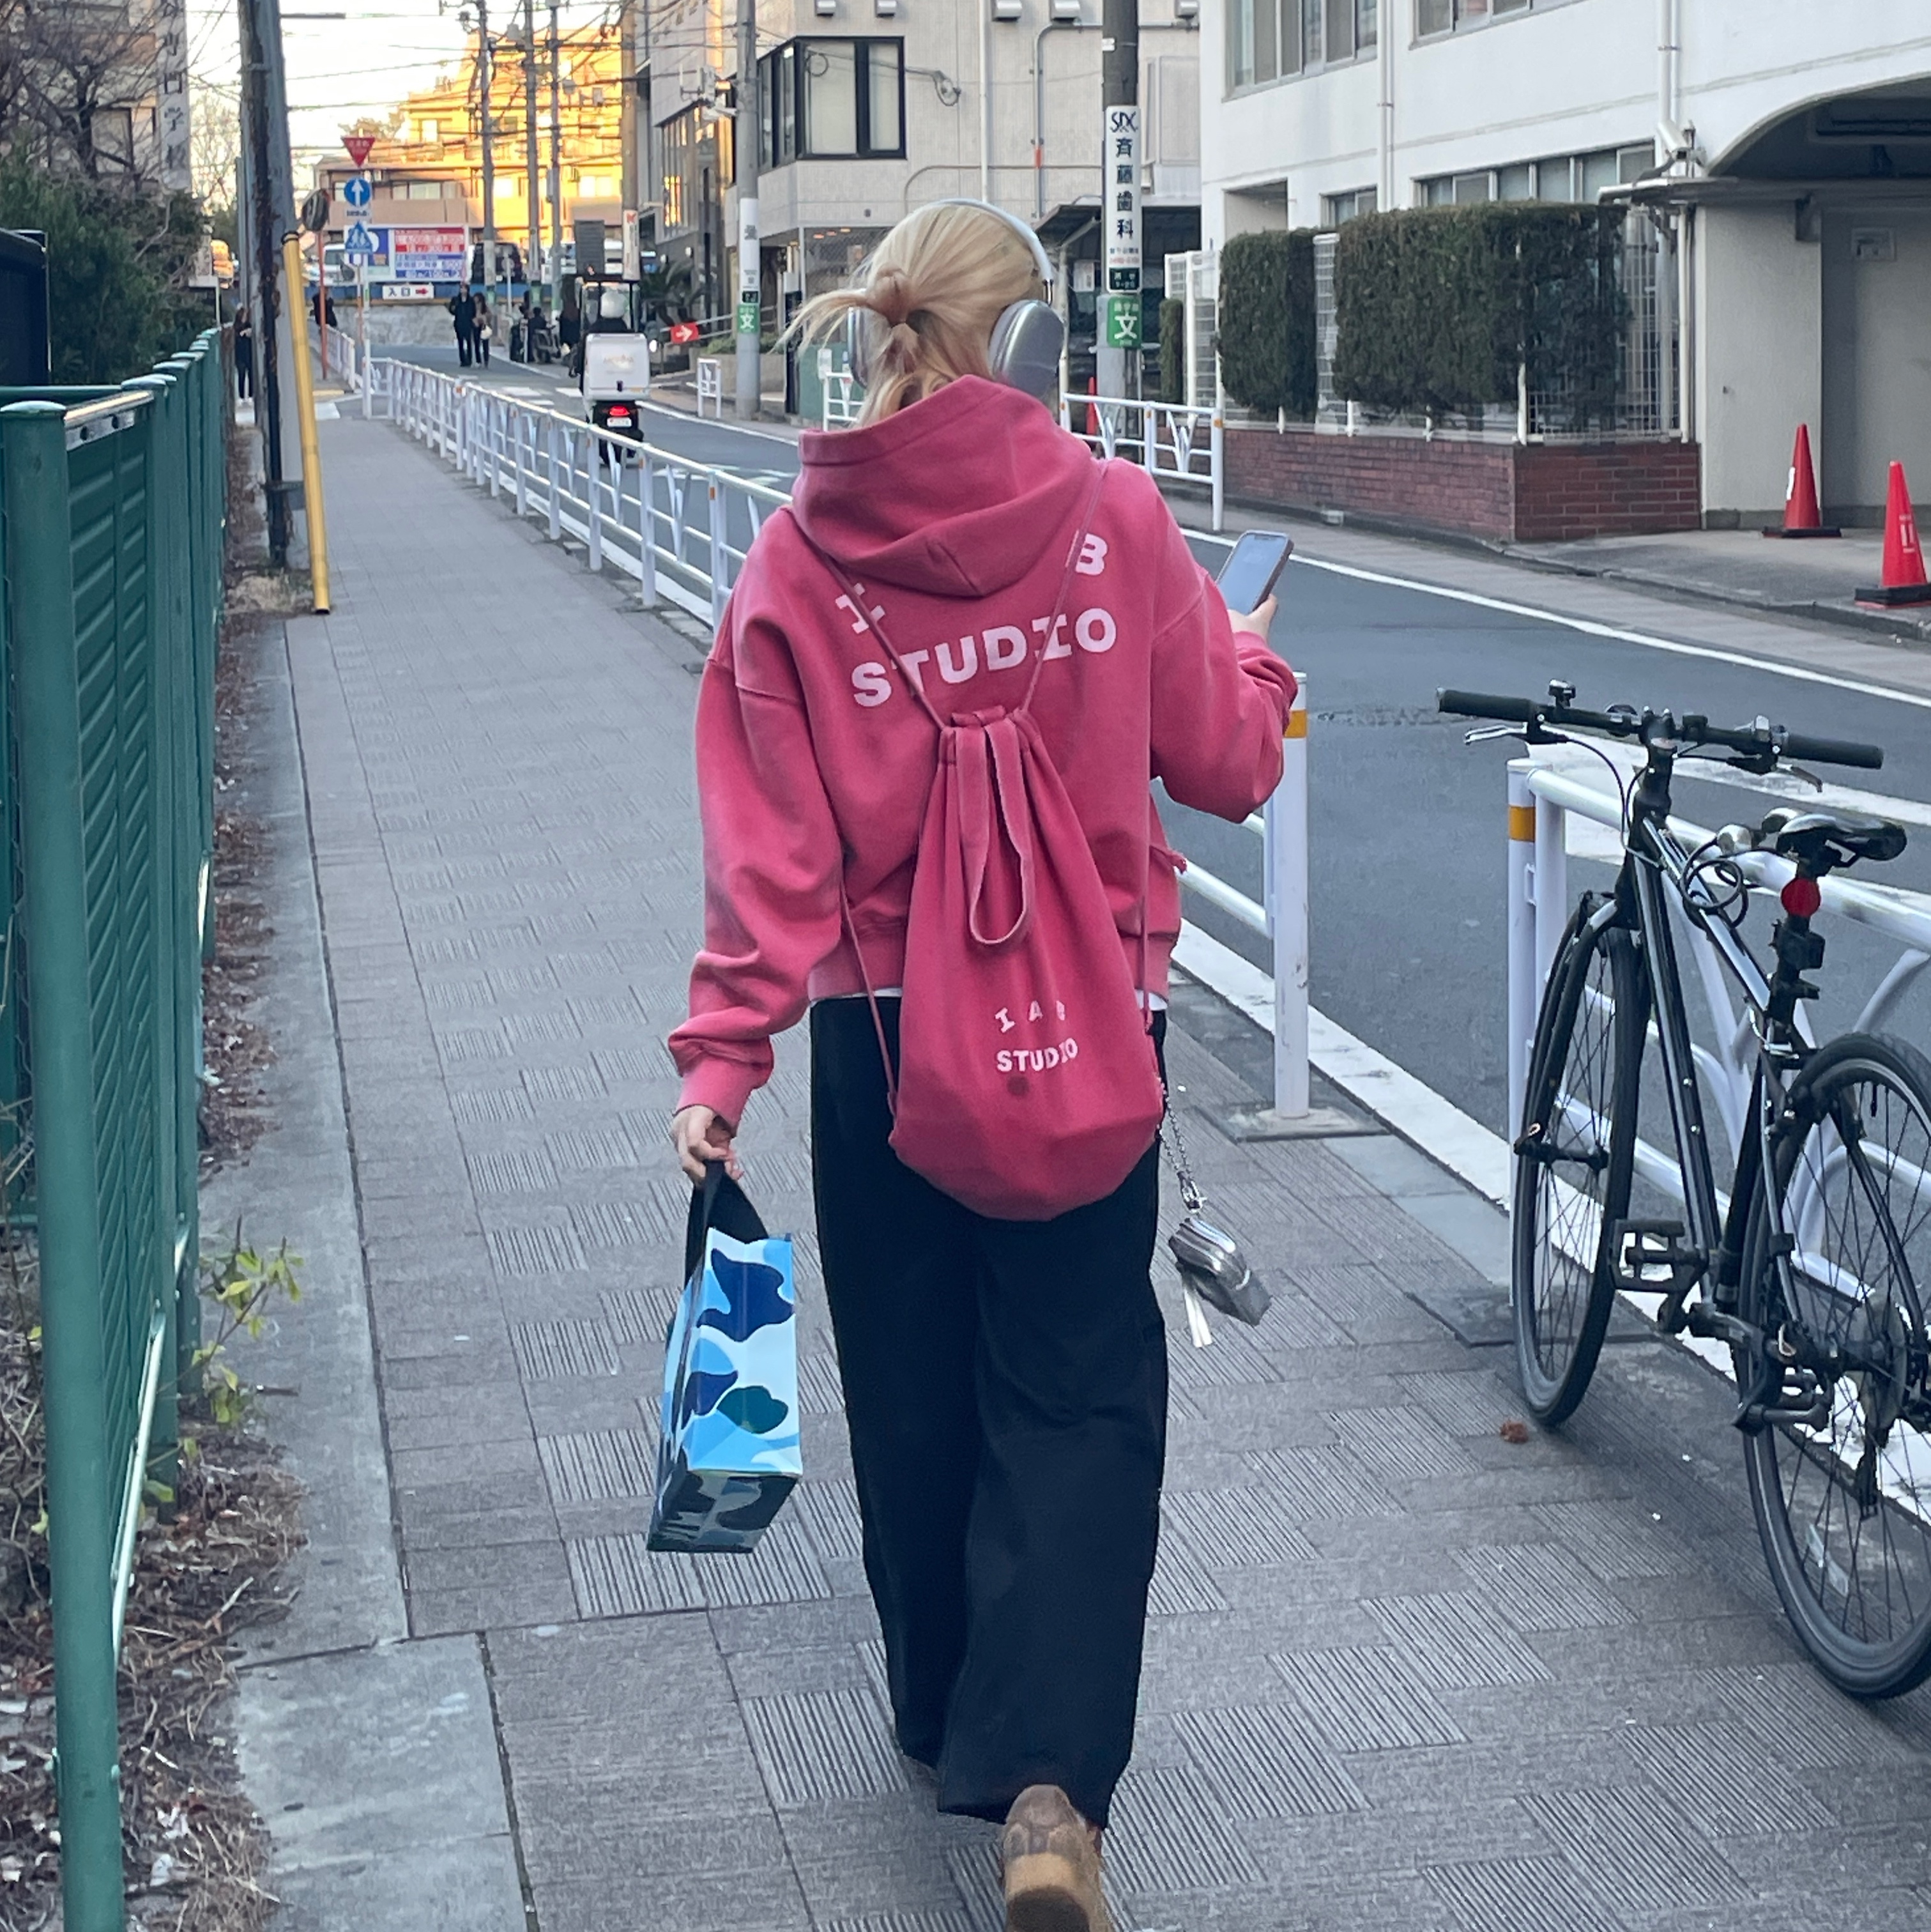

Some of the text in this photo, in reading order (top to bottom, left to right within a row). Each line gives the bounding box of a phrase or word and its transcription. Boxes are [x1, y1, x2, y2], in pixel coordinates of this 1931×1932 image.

[388, 287, 411, 296] 入口
[1114, 312, 1138, 339] 文
[851, 608, 1117, 707] STUDIO
[996, 1038, 1078, 1073] STUDIO
